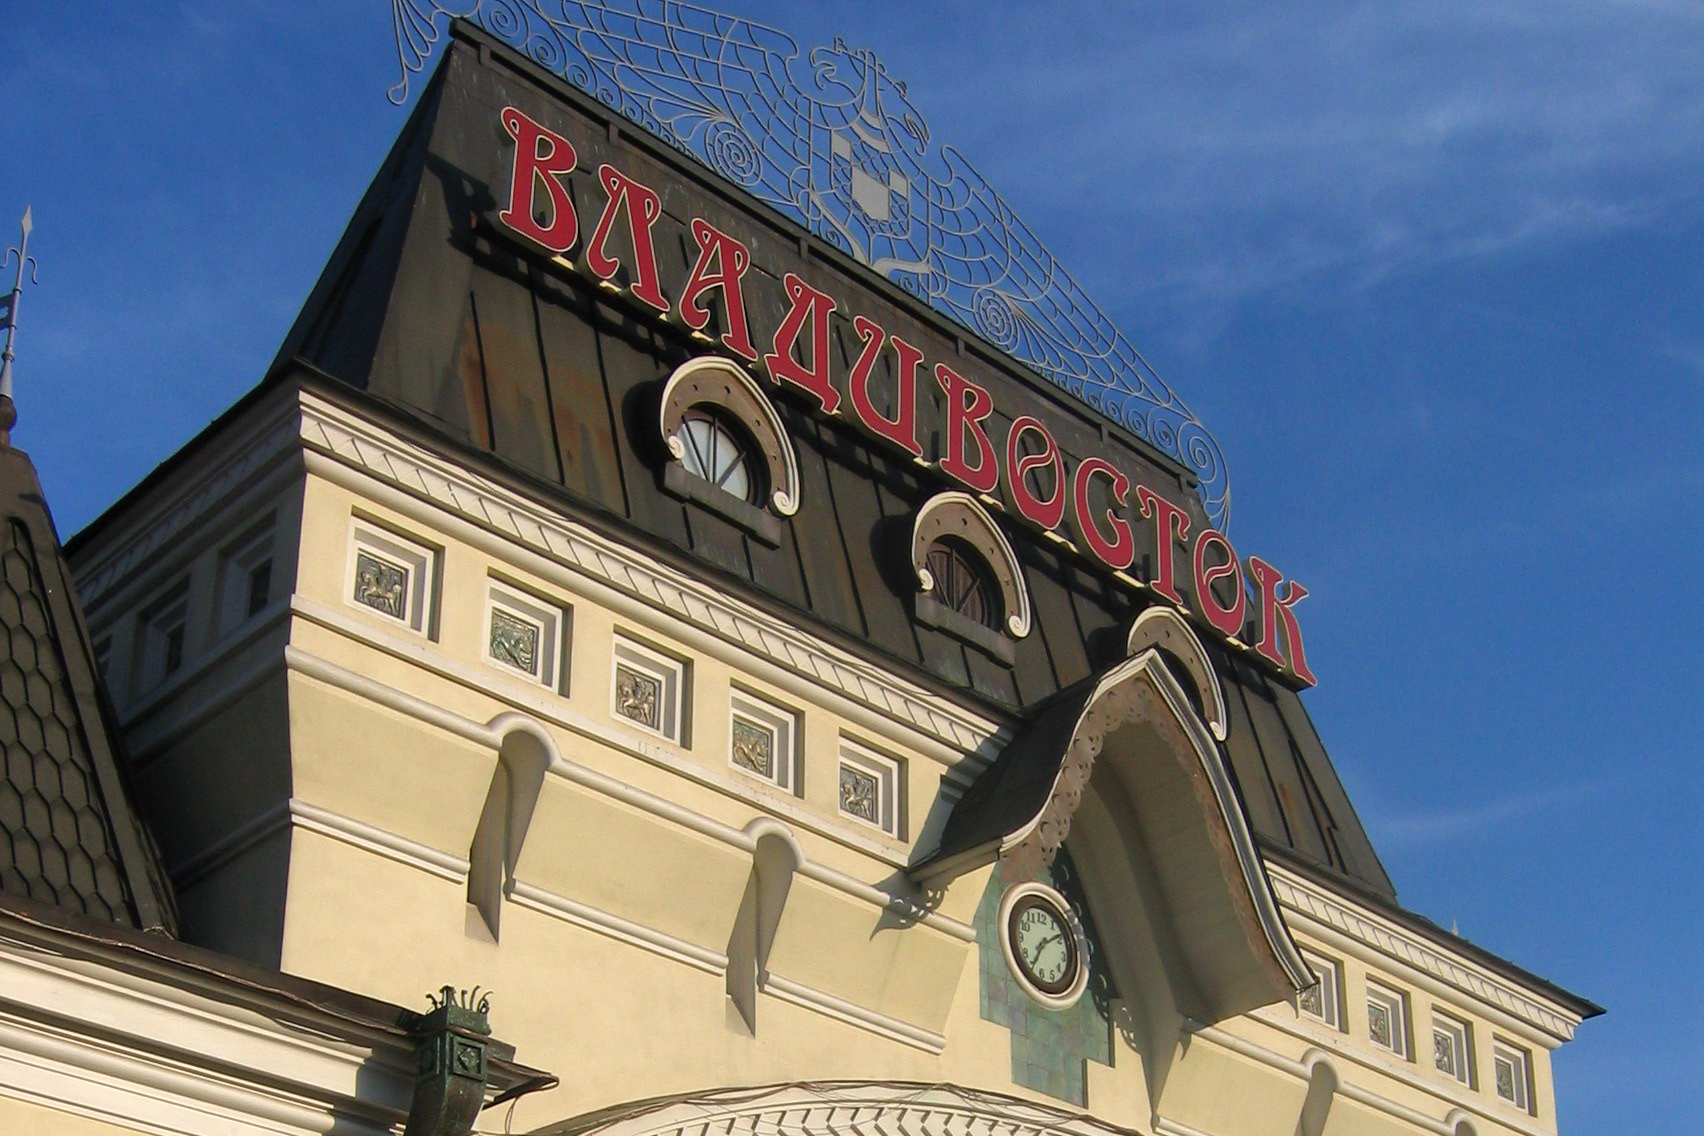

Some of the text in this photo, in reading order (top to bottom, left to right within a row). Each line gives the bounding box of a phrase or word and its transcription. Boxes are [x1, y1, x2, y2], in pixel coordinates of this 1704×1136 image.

[500, 105, 1318, 687] ВЛАДИВОСТОК
[1027, 911, 1036, 923] 11
[1036, 912, 1047, 925] 12
